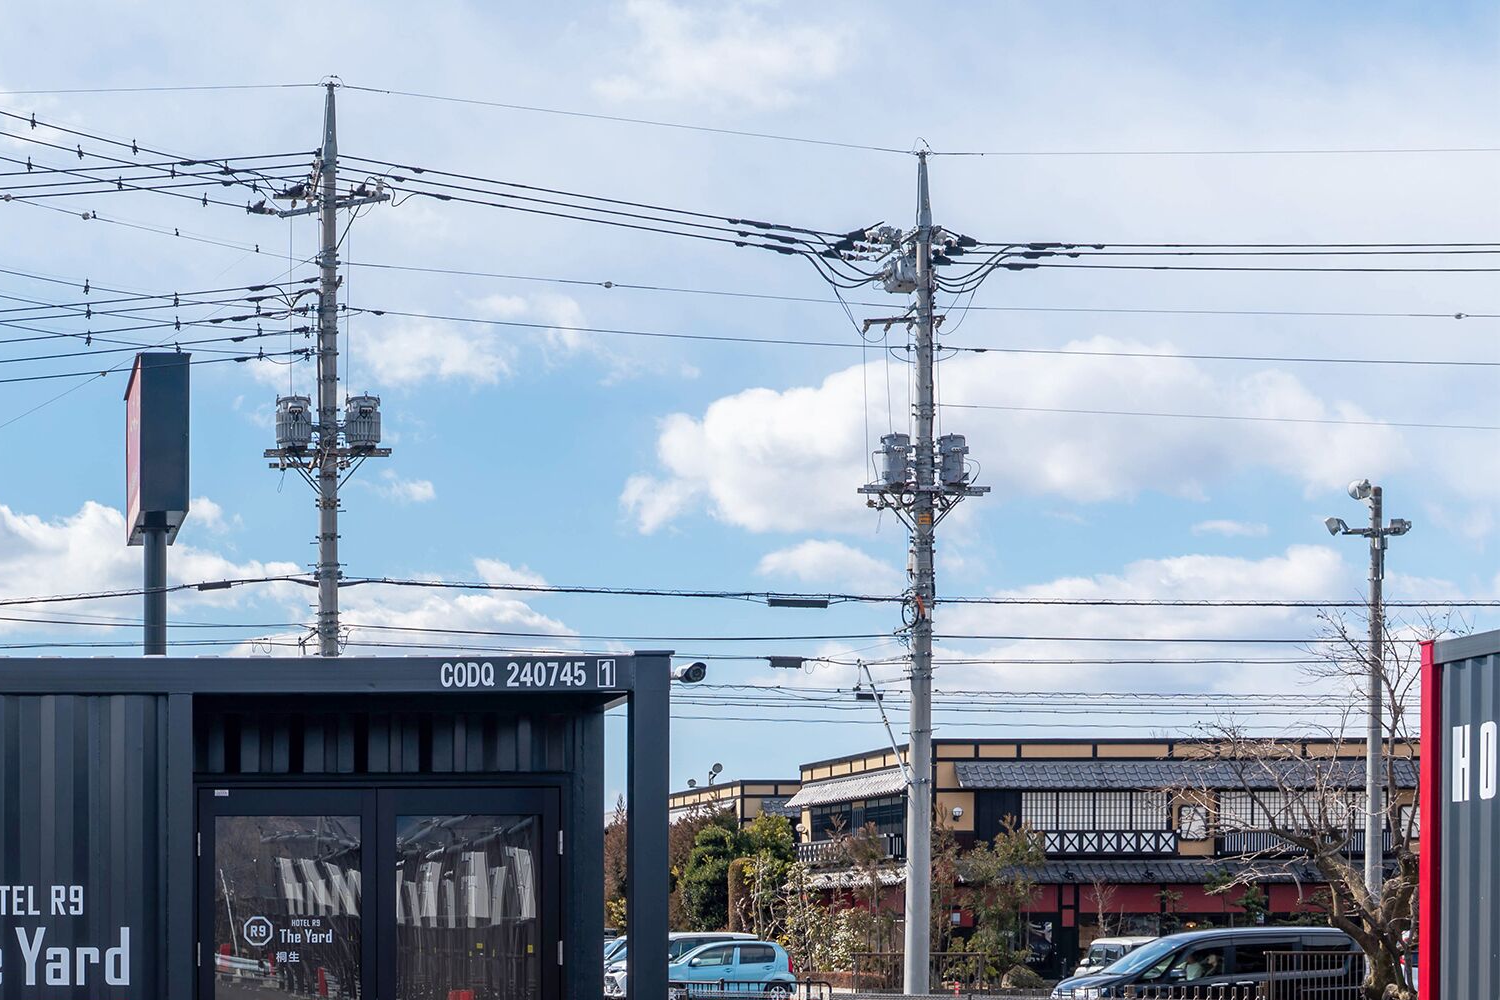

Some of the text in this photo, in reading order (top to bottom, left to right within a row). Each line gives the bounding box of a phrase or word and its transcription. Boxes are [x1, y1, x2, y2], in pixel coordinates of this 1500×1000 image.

[440, 661, 613, 688] CODQ 240745 1
[1452, 721, 1497, 803] HO
[51, 885, 84, 916] R9
[250, 925, 266, 937] R9
[291, 919, 321, 927] HOTEL R9
[279, 929, 333, 943] The Yard
[15, 926, 130, 986] Yard
[275, 951, 300, 963] 桐生
